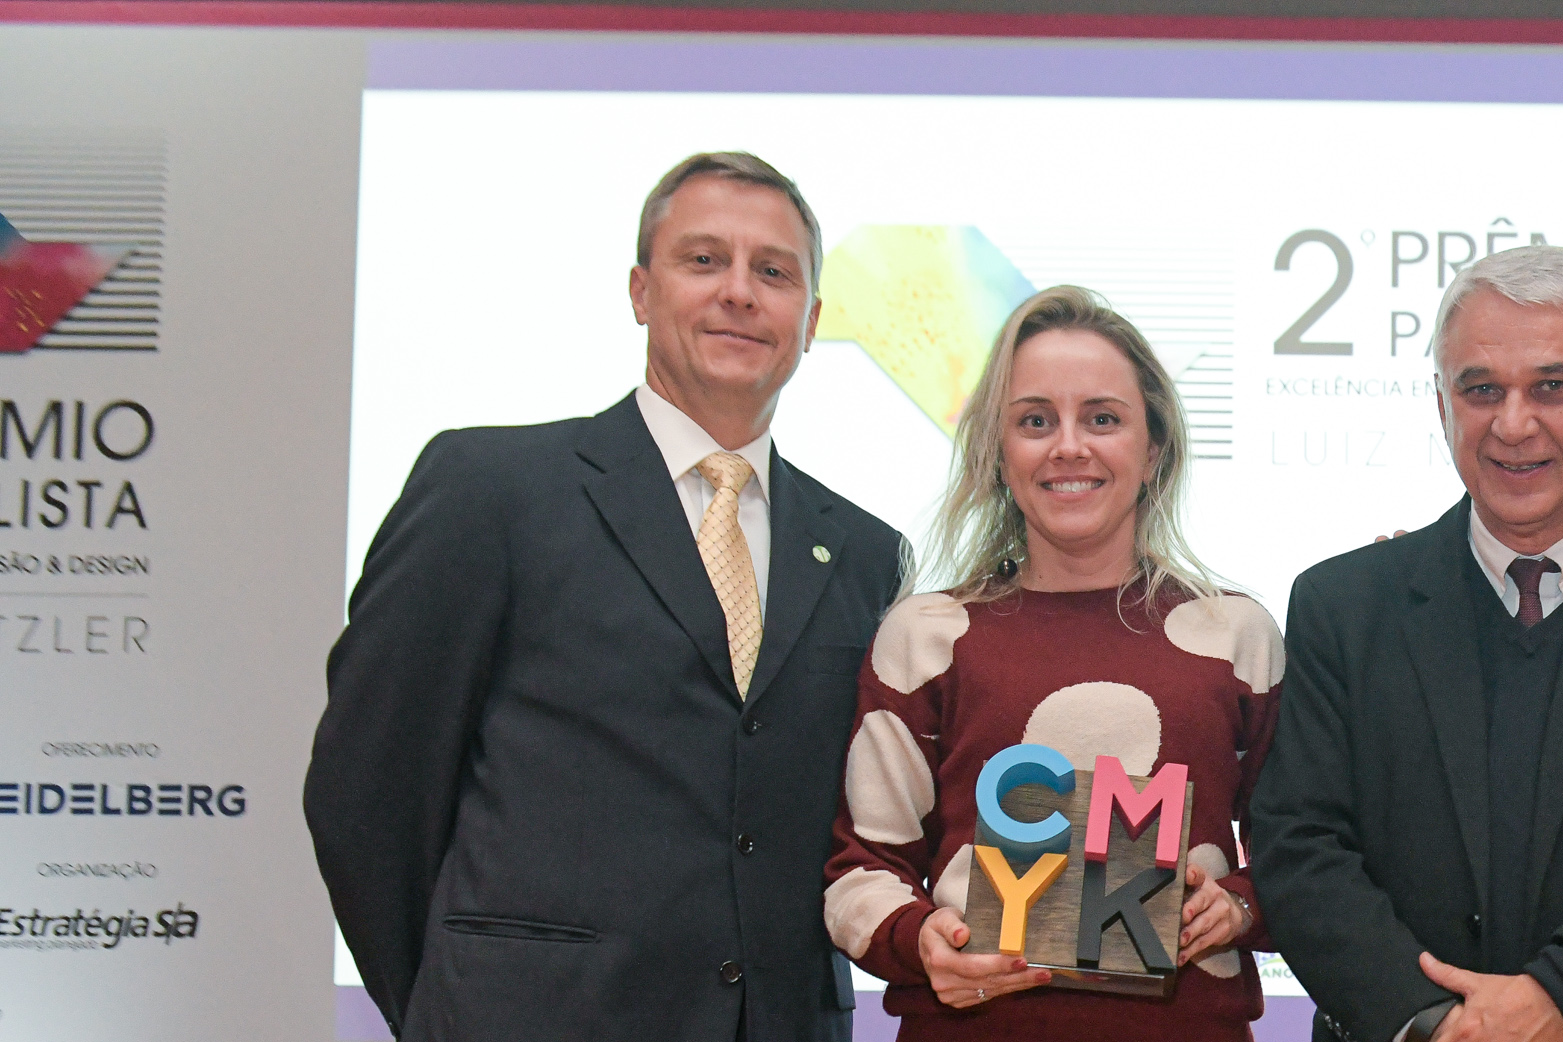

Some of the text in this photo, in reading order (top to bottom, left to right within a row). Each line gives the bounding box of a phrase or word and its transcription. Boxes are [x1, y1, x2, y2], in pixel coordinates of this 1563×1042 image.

[1266, 375, 1403, 397] EXCELÊNCIA
[1271, 431, 1388, 467] LUIZ
[0, 480, 149, 530] ISTA
[47, 555, 62, 575] &
[68, 555, 150, 576] DESIGN
[0, 614, 150, 654] ZLER
[41, 742, 161, 758] OFERECIMENTO
[37, 861, 158, 879] ORGANIZAÇÃO
